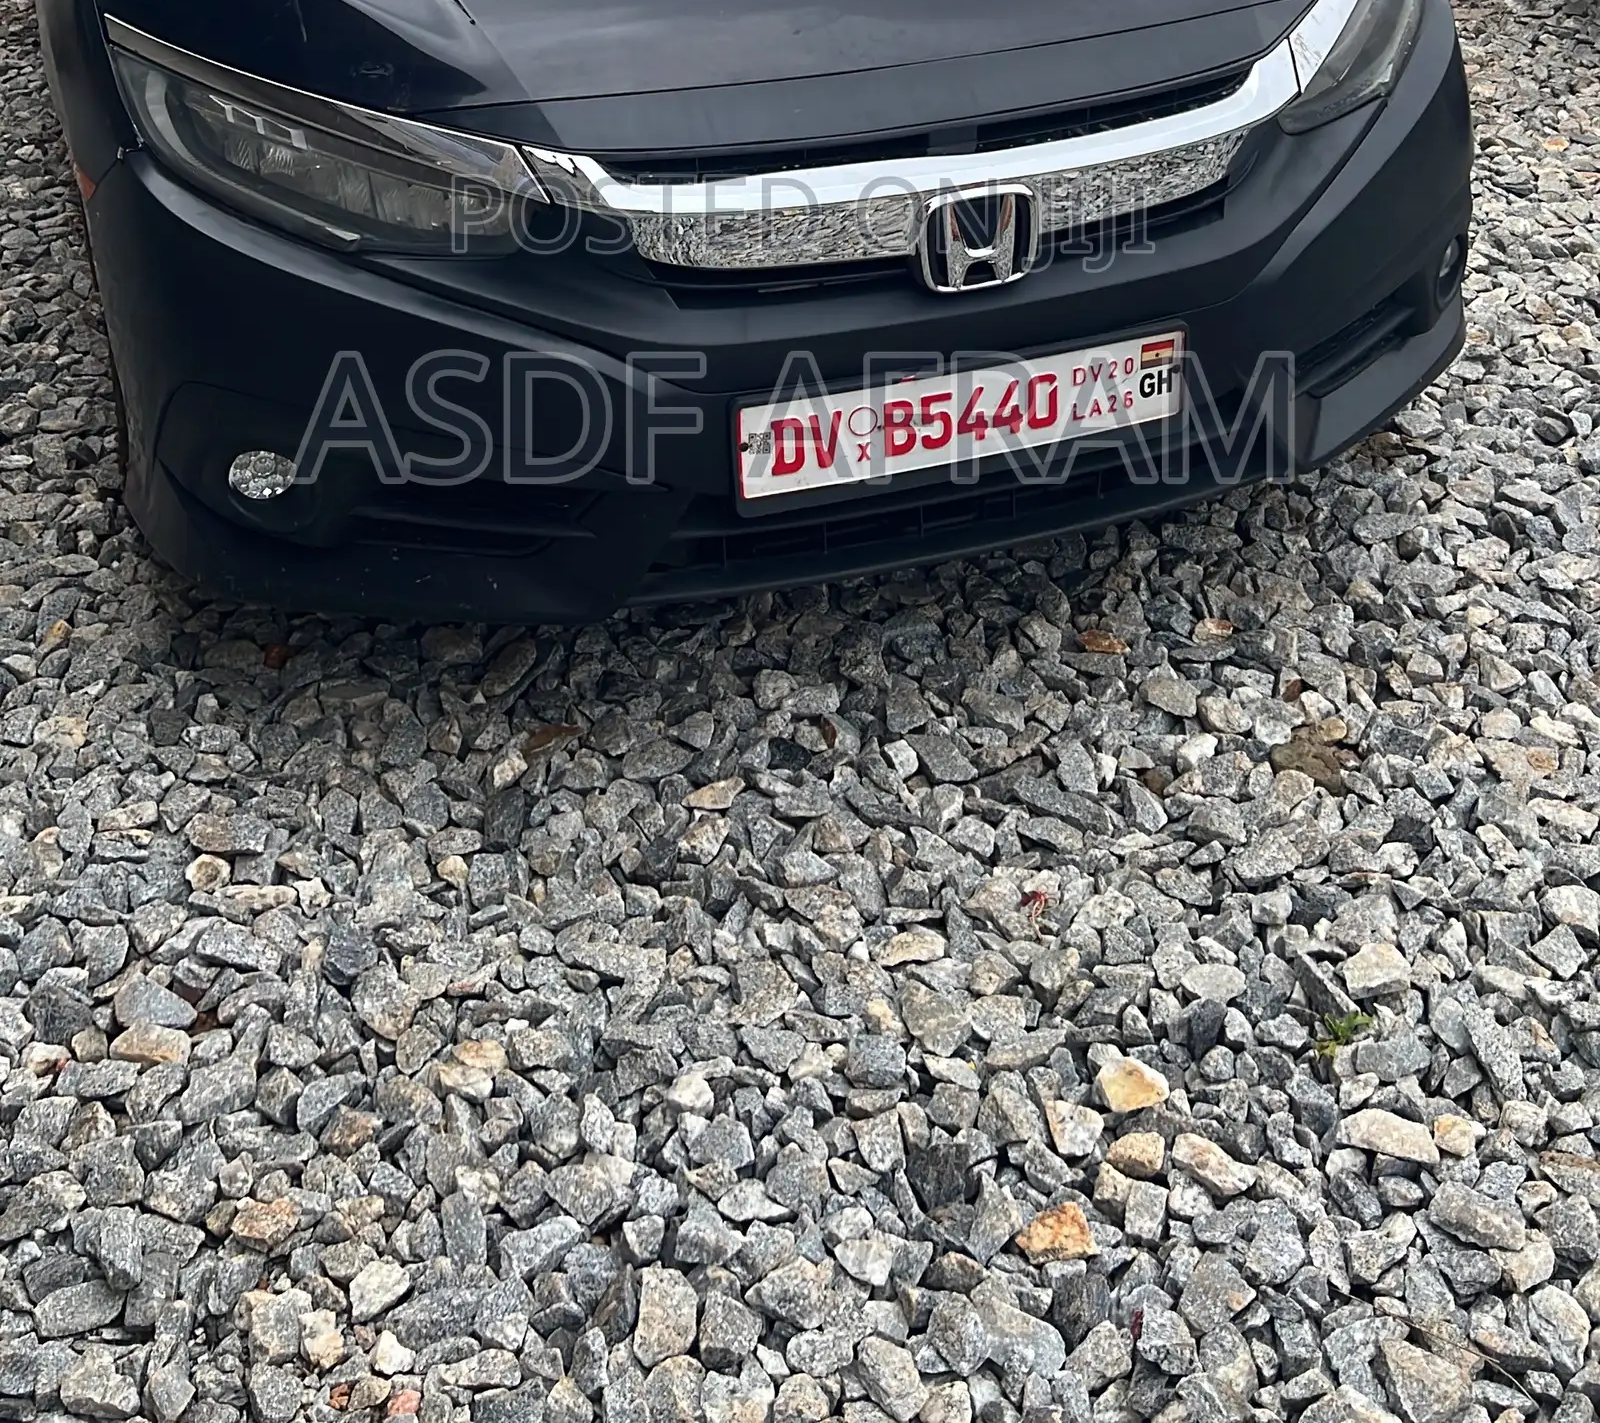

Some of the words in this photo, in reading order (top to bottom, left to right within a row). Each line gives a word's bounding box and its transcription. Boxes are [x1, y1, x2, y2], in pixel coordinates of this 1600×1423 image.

[1072, 357, 1135, 387] DV20
[1139, 368, 1174, 399] GH
[1072, 390, 1134, 422] LA26
[770, 409, 843, 477] DV
[881, 373, 1060, 458] B5440
